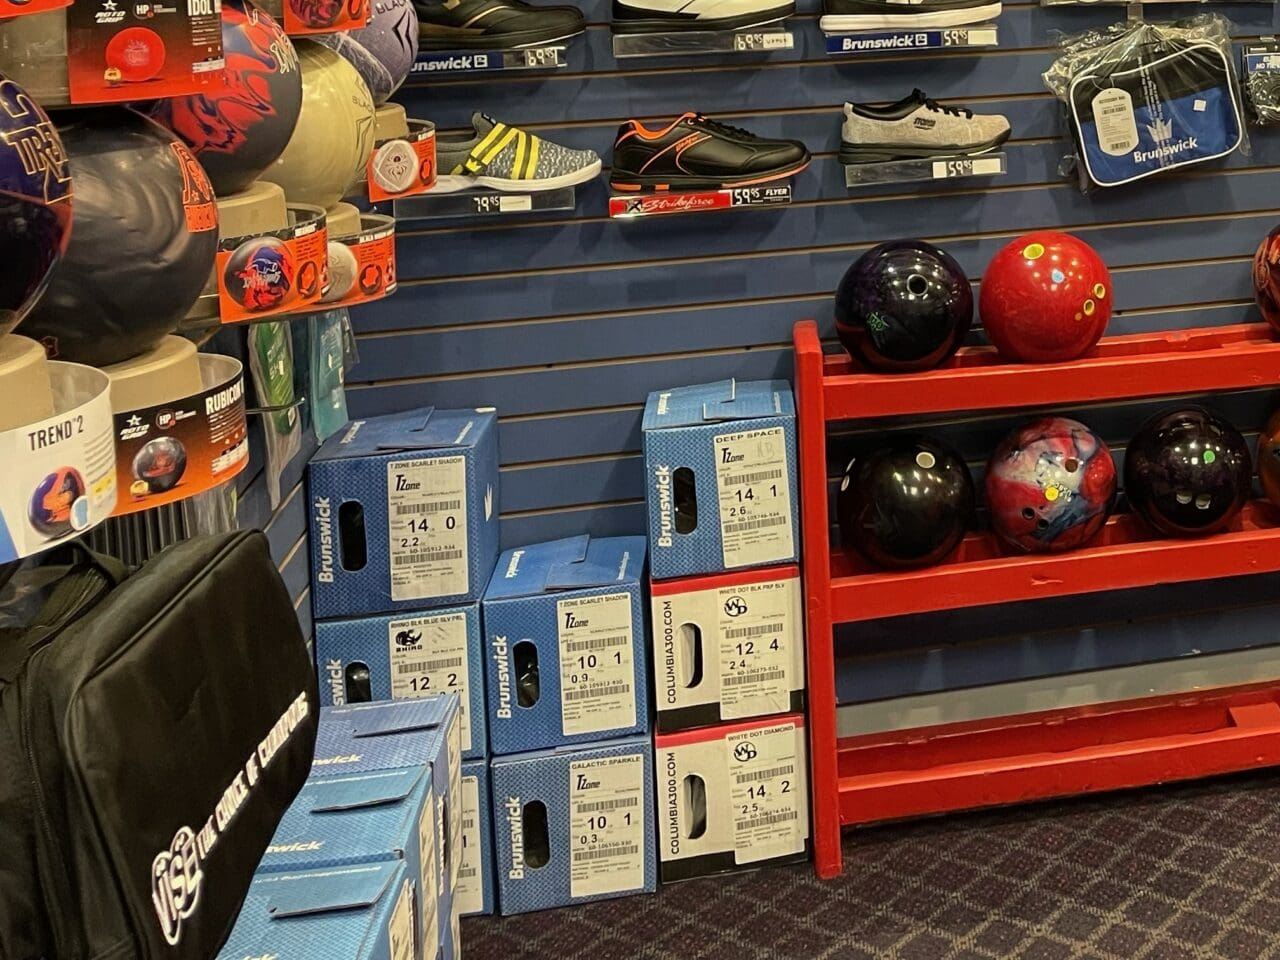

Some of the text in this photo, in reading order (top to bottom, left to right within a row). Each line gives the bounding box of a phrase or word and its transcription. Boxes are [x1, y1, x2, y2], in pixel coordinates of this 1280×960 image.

[95, 10, 126, 18] ROTO
[136, 4, 150, 15] HP
[843, 34, 914, 50] Brunswick
[1133, 136, 1199, 164] Brunswick
[642, 188, 788, 211] Strikeforce FLYER
[206, 381, 241, 416] RUBICON
[28, 415, 85, 452] TREND 2
[715, 429, 782, 444] DEEP SPACE
[394, 461, 410, 469] ZONE
[411, 460, 438, 468] SCARLET
[438, 458, 463, 466] SHADOW
[734, 484, 778, 503] 14 1
[655, 464, 673, 547] Brunswick
[729, 507, 747, 518] 2.6
[407, 516, 456, 533] 14 0
[314, 495, 334, 583] Brunswick
[401, 537, 420, 548] 2.2
[719, 587, 736, 595] WHITE
[737, 586, 750, 594] DOT
[563, 600, 578, 608] ZONE
[579, 597, 604, 606] SCARLET
[604, 594, 629, 603] SHADOW
[391, 621, 410, 629] RHINO
[396, 645, 423, 653] RHINO
[663, 600, 677, 704] COLUMBIA300.COM
[735, 638, 779, 656] 12 4
[577, 651, 622, 670] 10 1
[729, 659, 746, 670] 2.4
[326, 658, 344, 707] swick
[409, 673, 458, 692] 12 2
[492, 635, 512, 719] Brunswick
[571, 673, 589, 684] 0.9
[728, 733, 748, 741] WHITE
[763, 725, 794, 736] DIAMOND
[572, 756, 641, 770] GALACTIC SPARKLE
[747, 780, 791, 800] 14 2
[667, 752, 680, 855] COLUMBIA300.COM
[741, 803, 759, 814] 2.5
[587, 812, 632, 831] 10 1
[505, 796, 525, 880] Brunswick
[580, 834, 598, 845] 0.3
[152, 826, 203, 946] VISE
